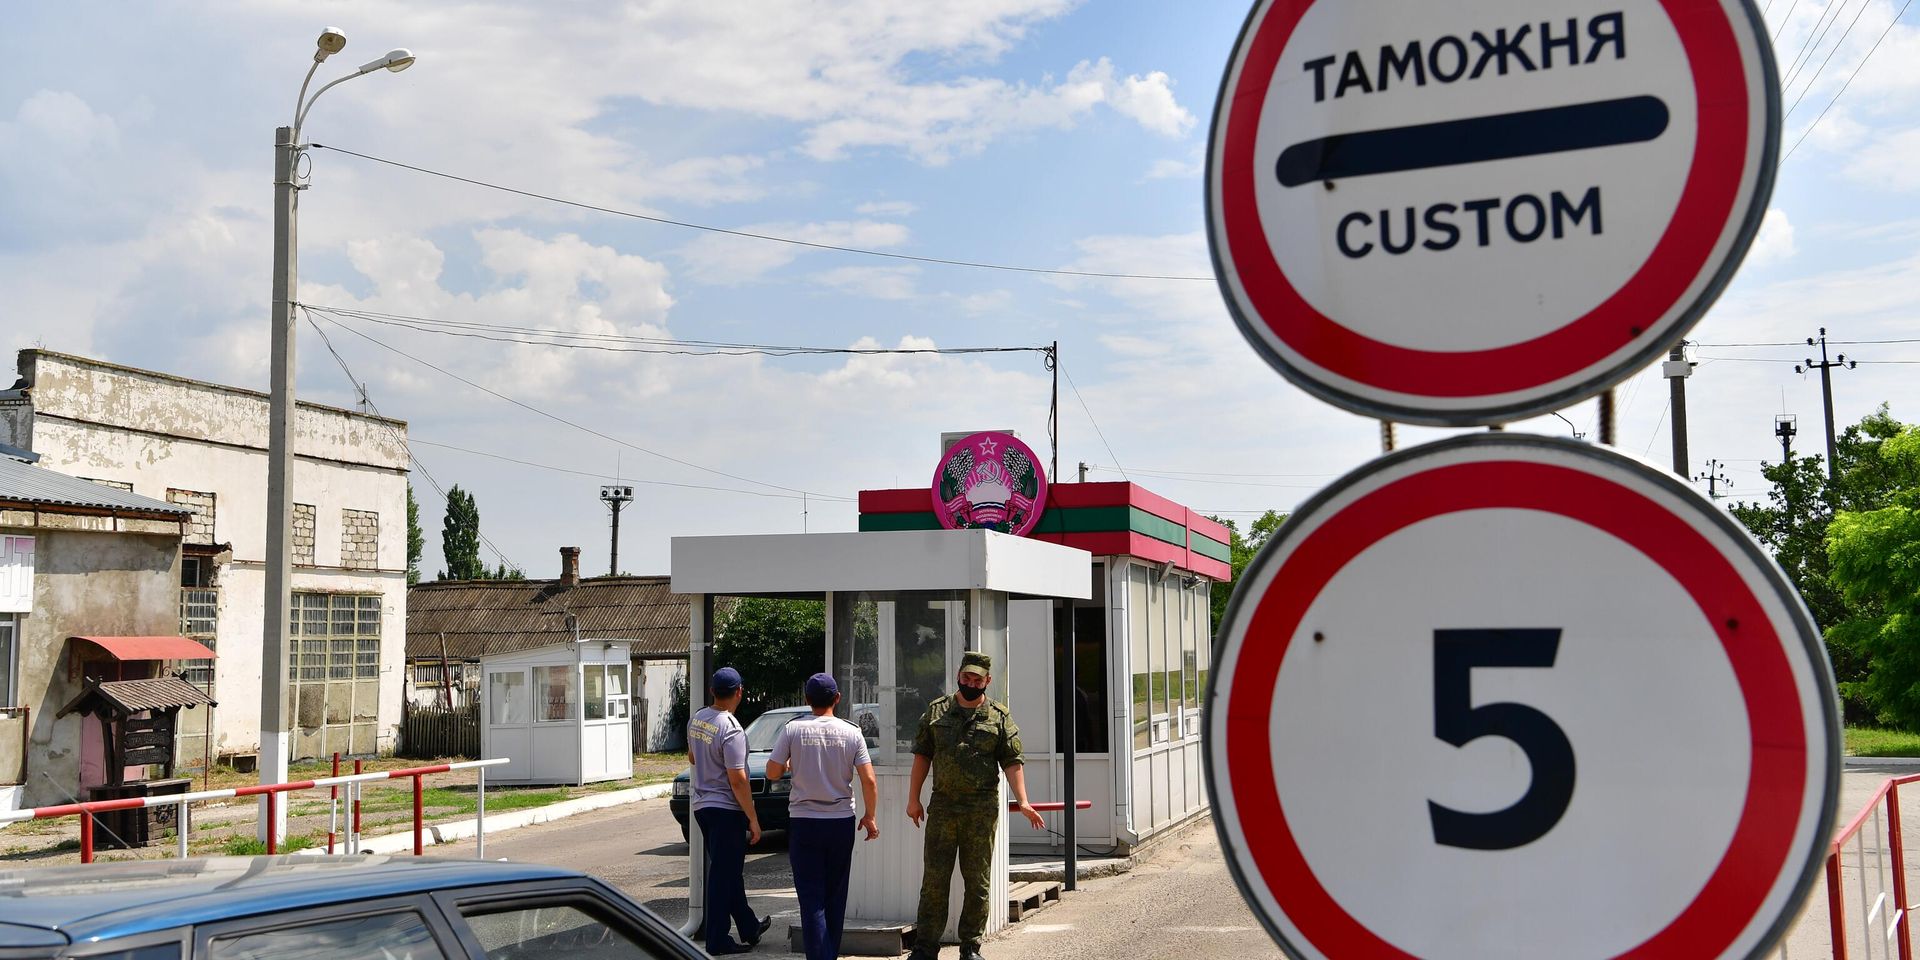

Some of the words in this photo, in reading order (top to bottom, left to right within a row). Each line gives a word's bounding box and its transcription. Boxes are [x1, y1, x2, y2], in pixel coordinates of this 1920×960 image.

[1303, 11, 1626, 103] ТАМОЖНЯ
[1336, 186, 1603, 260] CUSTOM
[799, 727, 849, 737] ТАМОЖНЯ
[801, 738, 846, 748] CUSTOMS
[1427, 627, 1577, 852] 5
